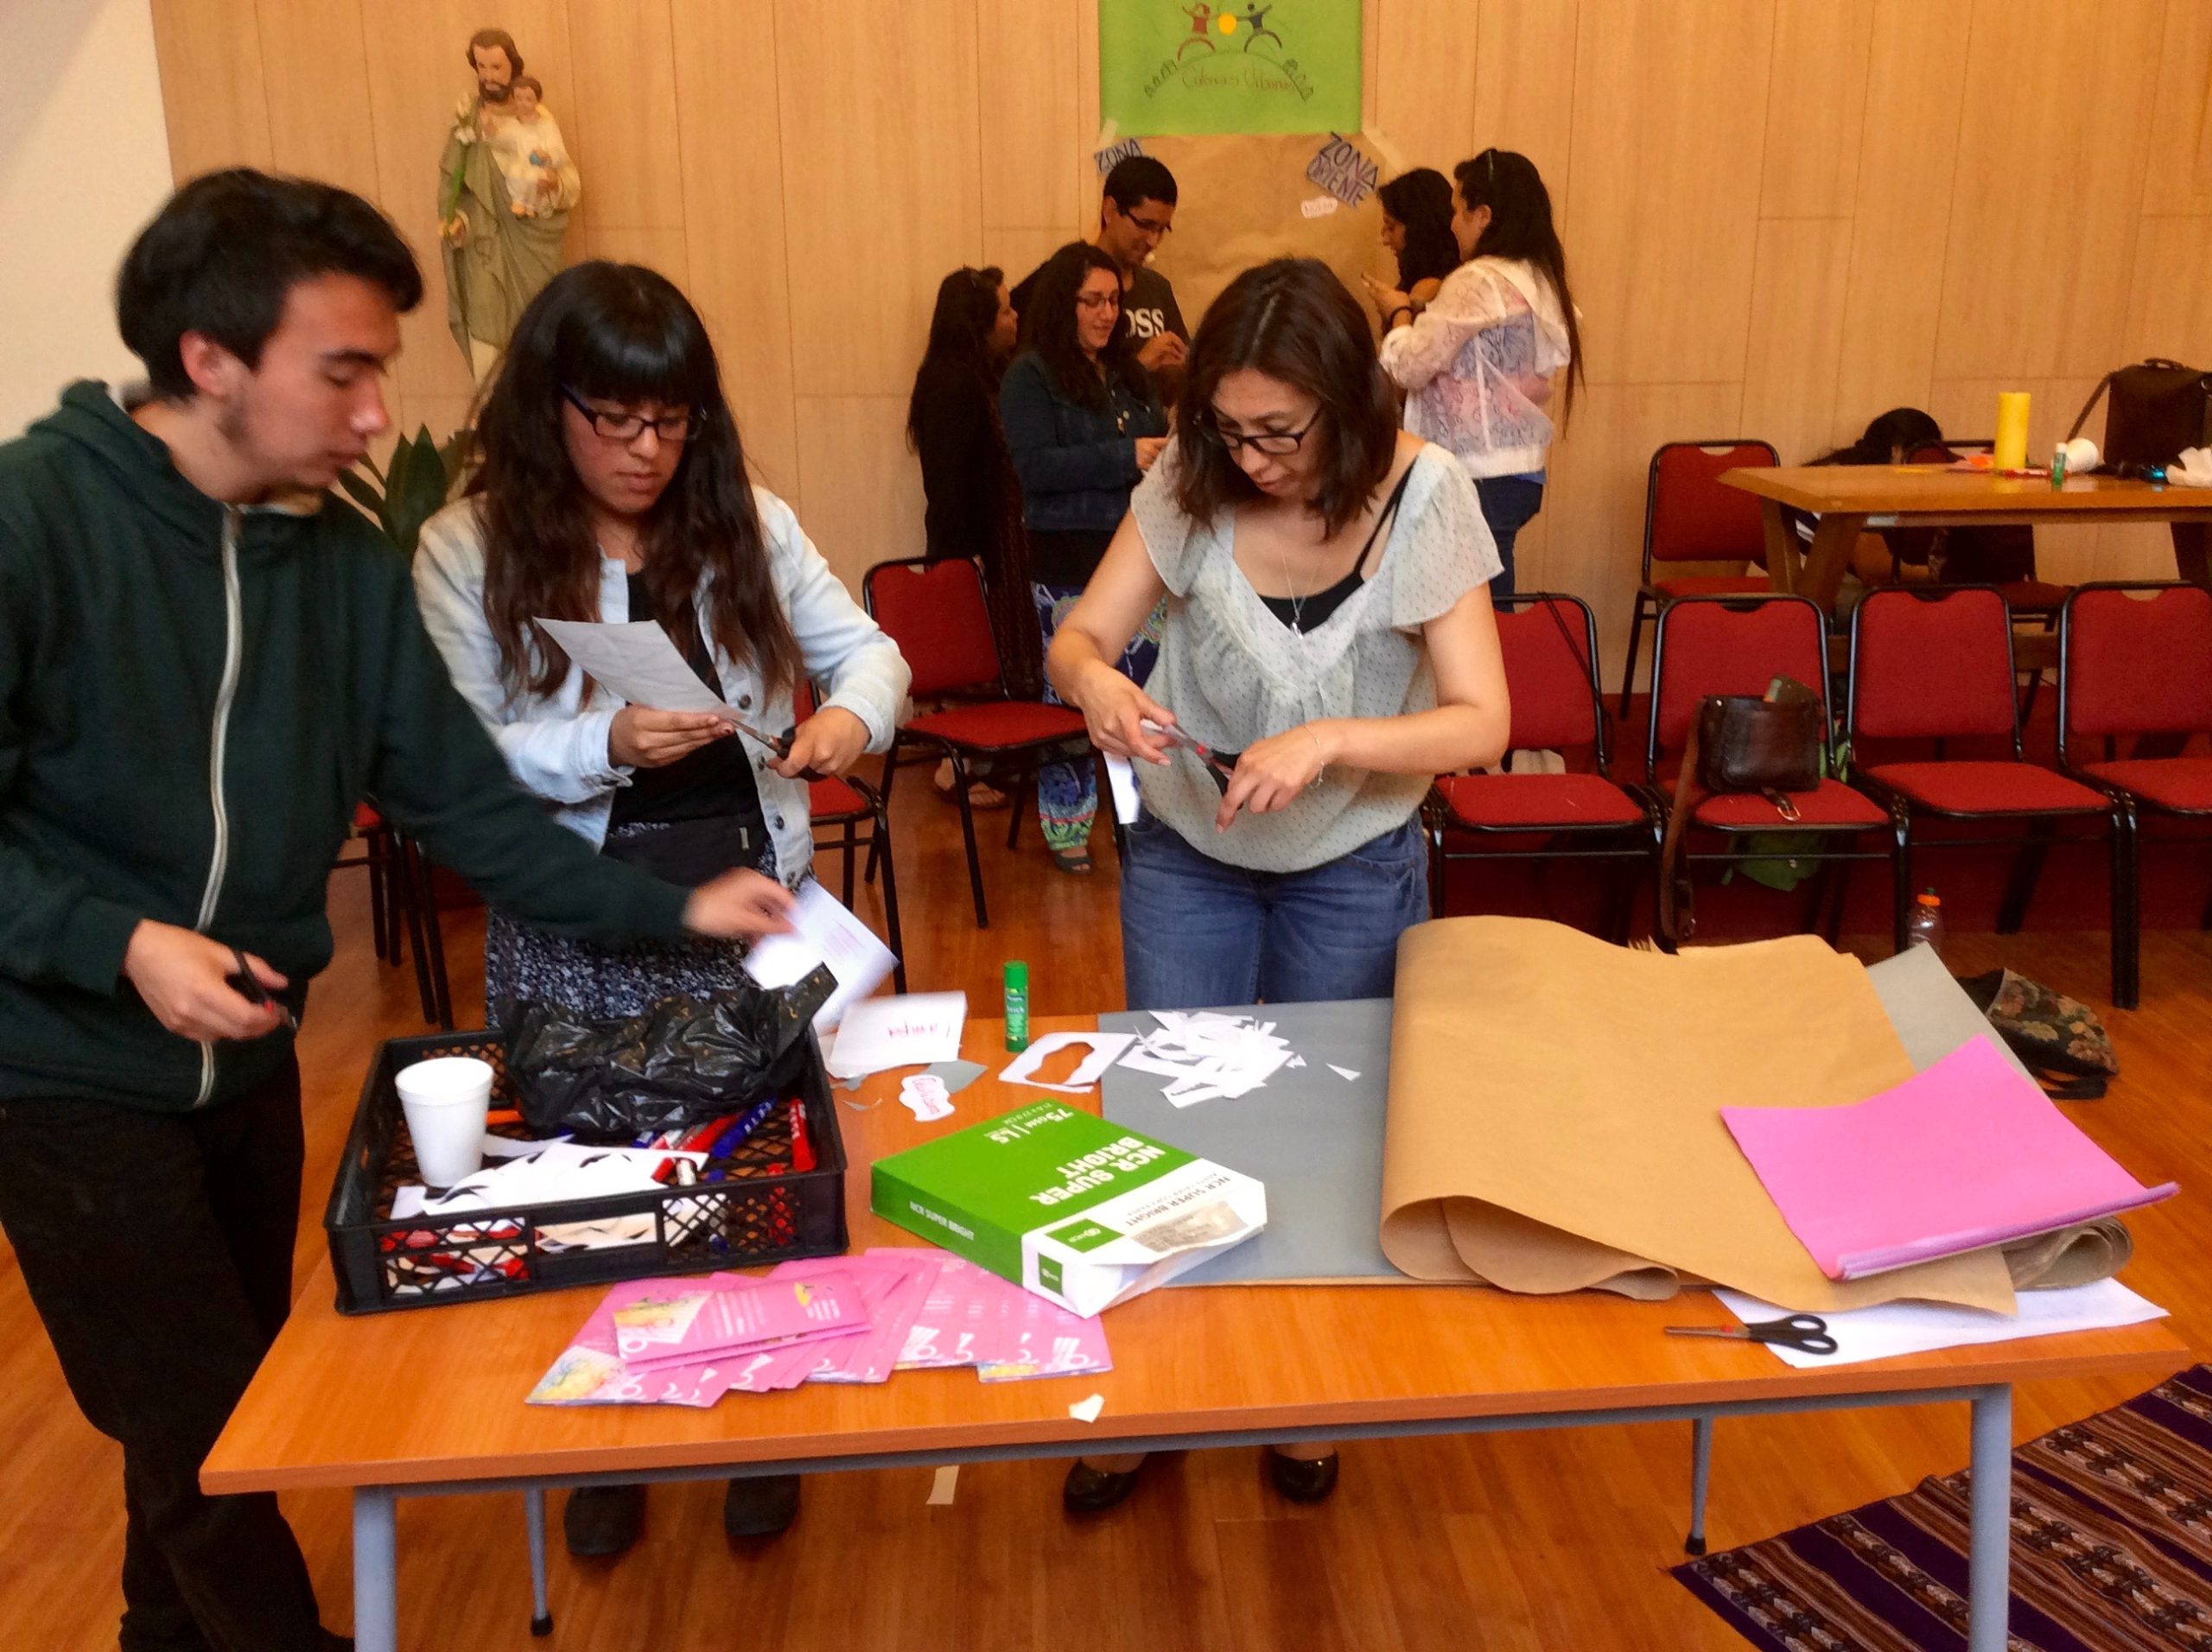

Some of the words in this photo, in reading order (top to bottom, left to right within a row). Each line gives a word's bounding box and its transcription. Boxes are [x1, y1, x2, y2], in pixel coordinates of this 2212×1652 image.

[1094, 138, 1142, 173] ZONA
[1319, 131, 1377, 191] ZONA
[1056, 1136, 1144, 1179] BRIGHT
[1109, 1145, 1166, 1172] NCR
[1028, 1169, 1115, 1205] SUPER
[1168, 1188, 1206, 1207] SUPER
[1205, 1176, 1230, 1190] NCR
[1125, 1204, 1169, 1227] BRIGHT
